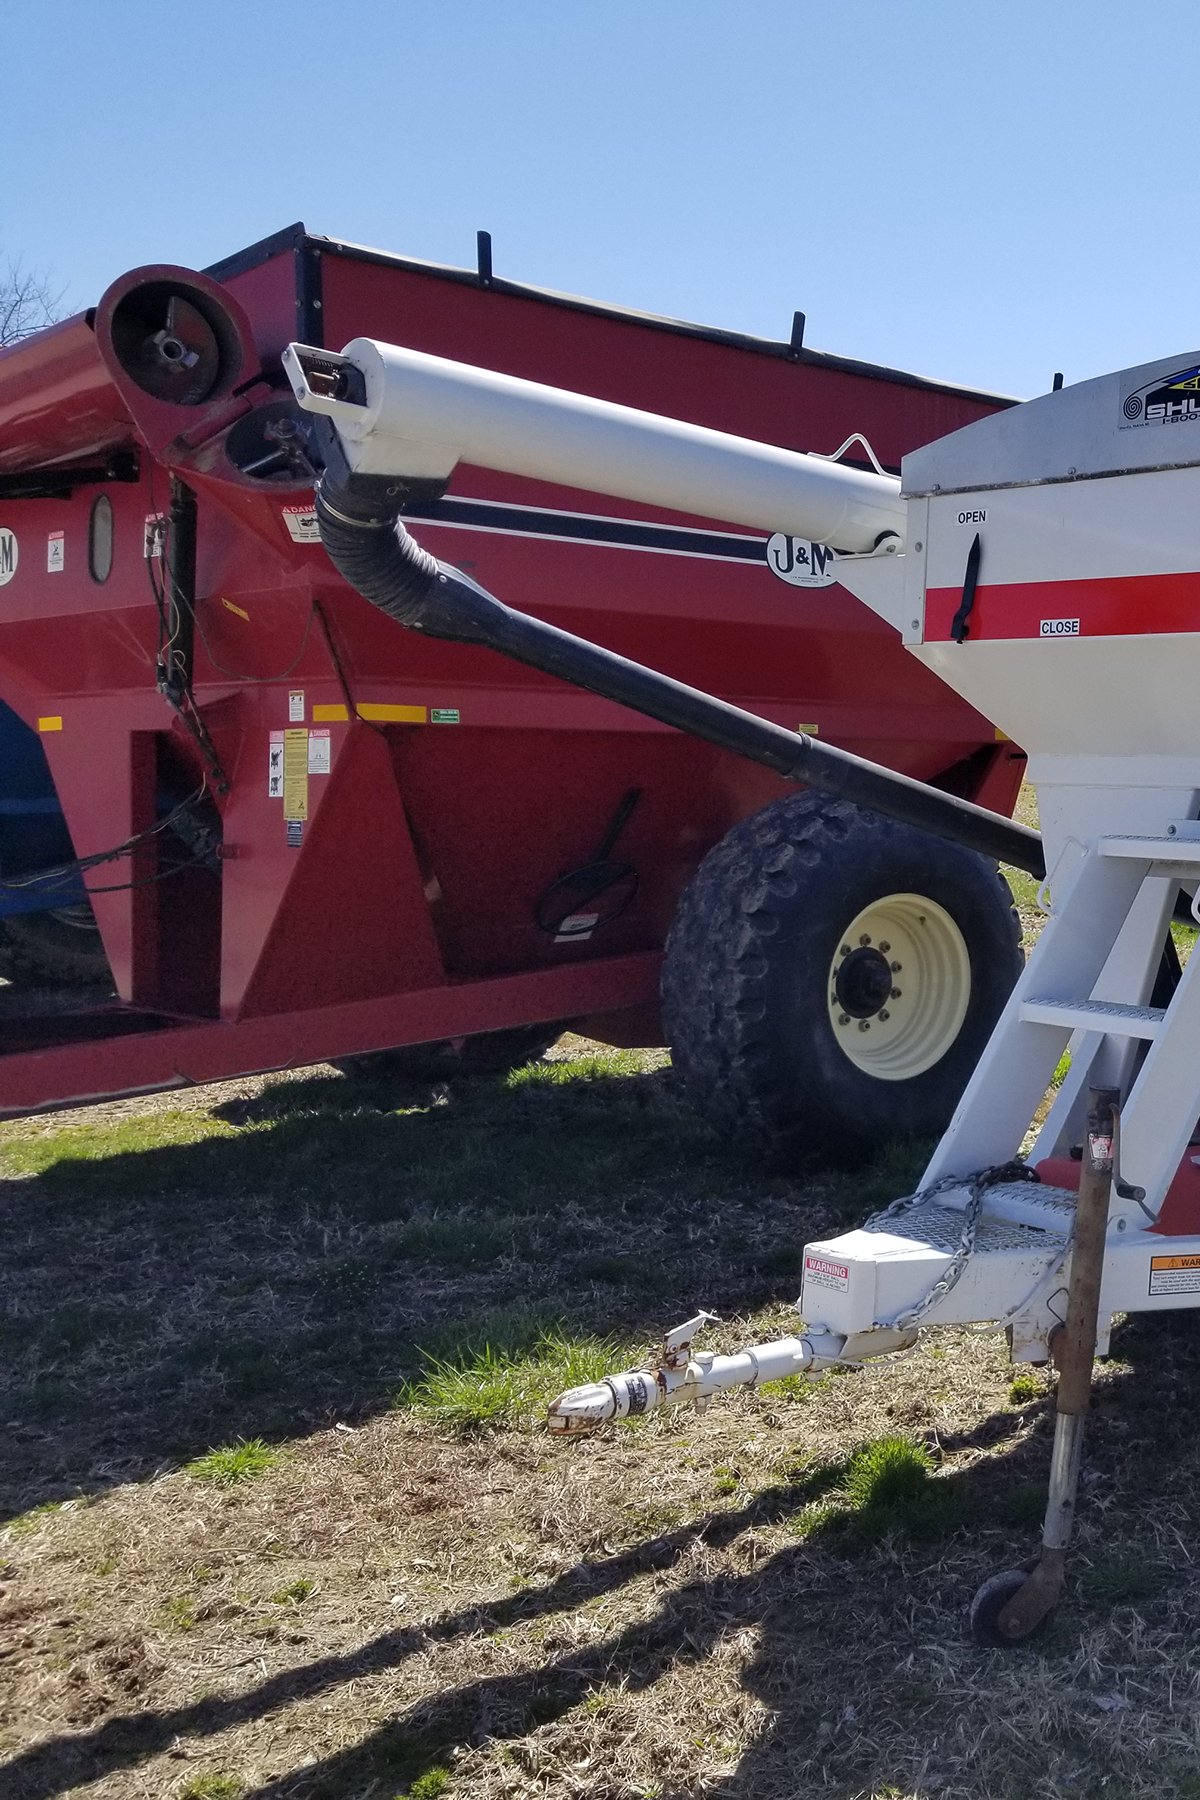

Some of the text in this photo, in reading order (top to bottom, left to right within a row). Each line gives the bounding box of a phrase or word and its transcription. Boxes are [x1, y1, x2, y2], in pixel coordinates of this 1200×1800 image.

[958, 510, 986, 524] OPEN
[773, 534, 834, 577] J&M
[1041, 620, 1079, 634] CLOSE
[809, 1258, 846, 1277] WARNING
